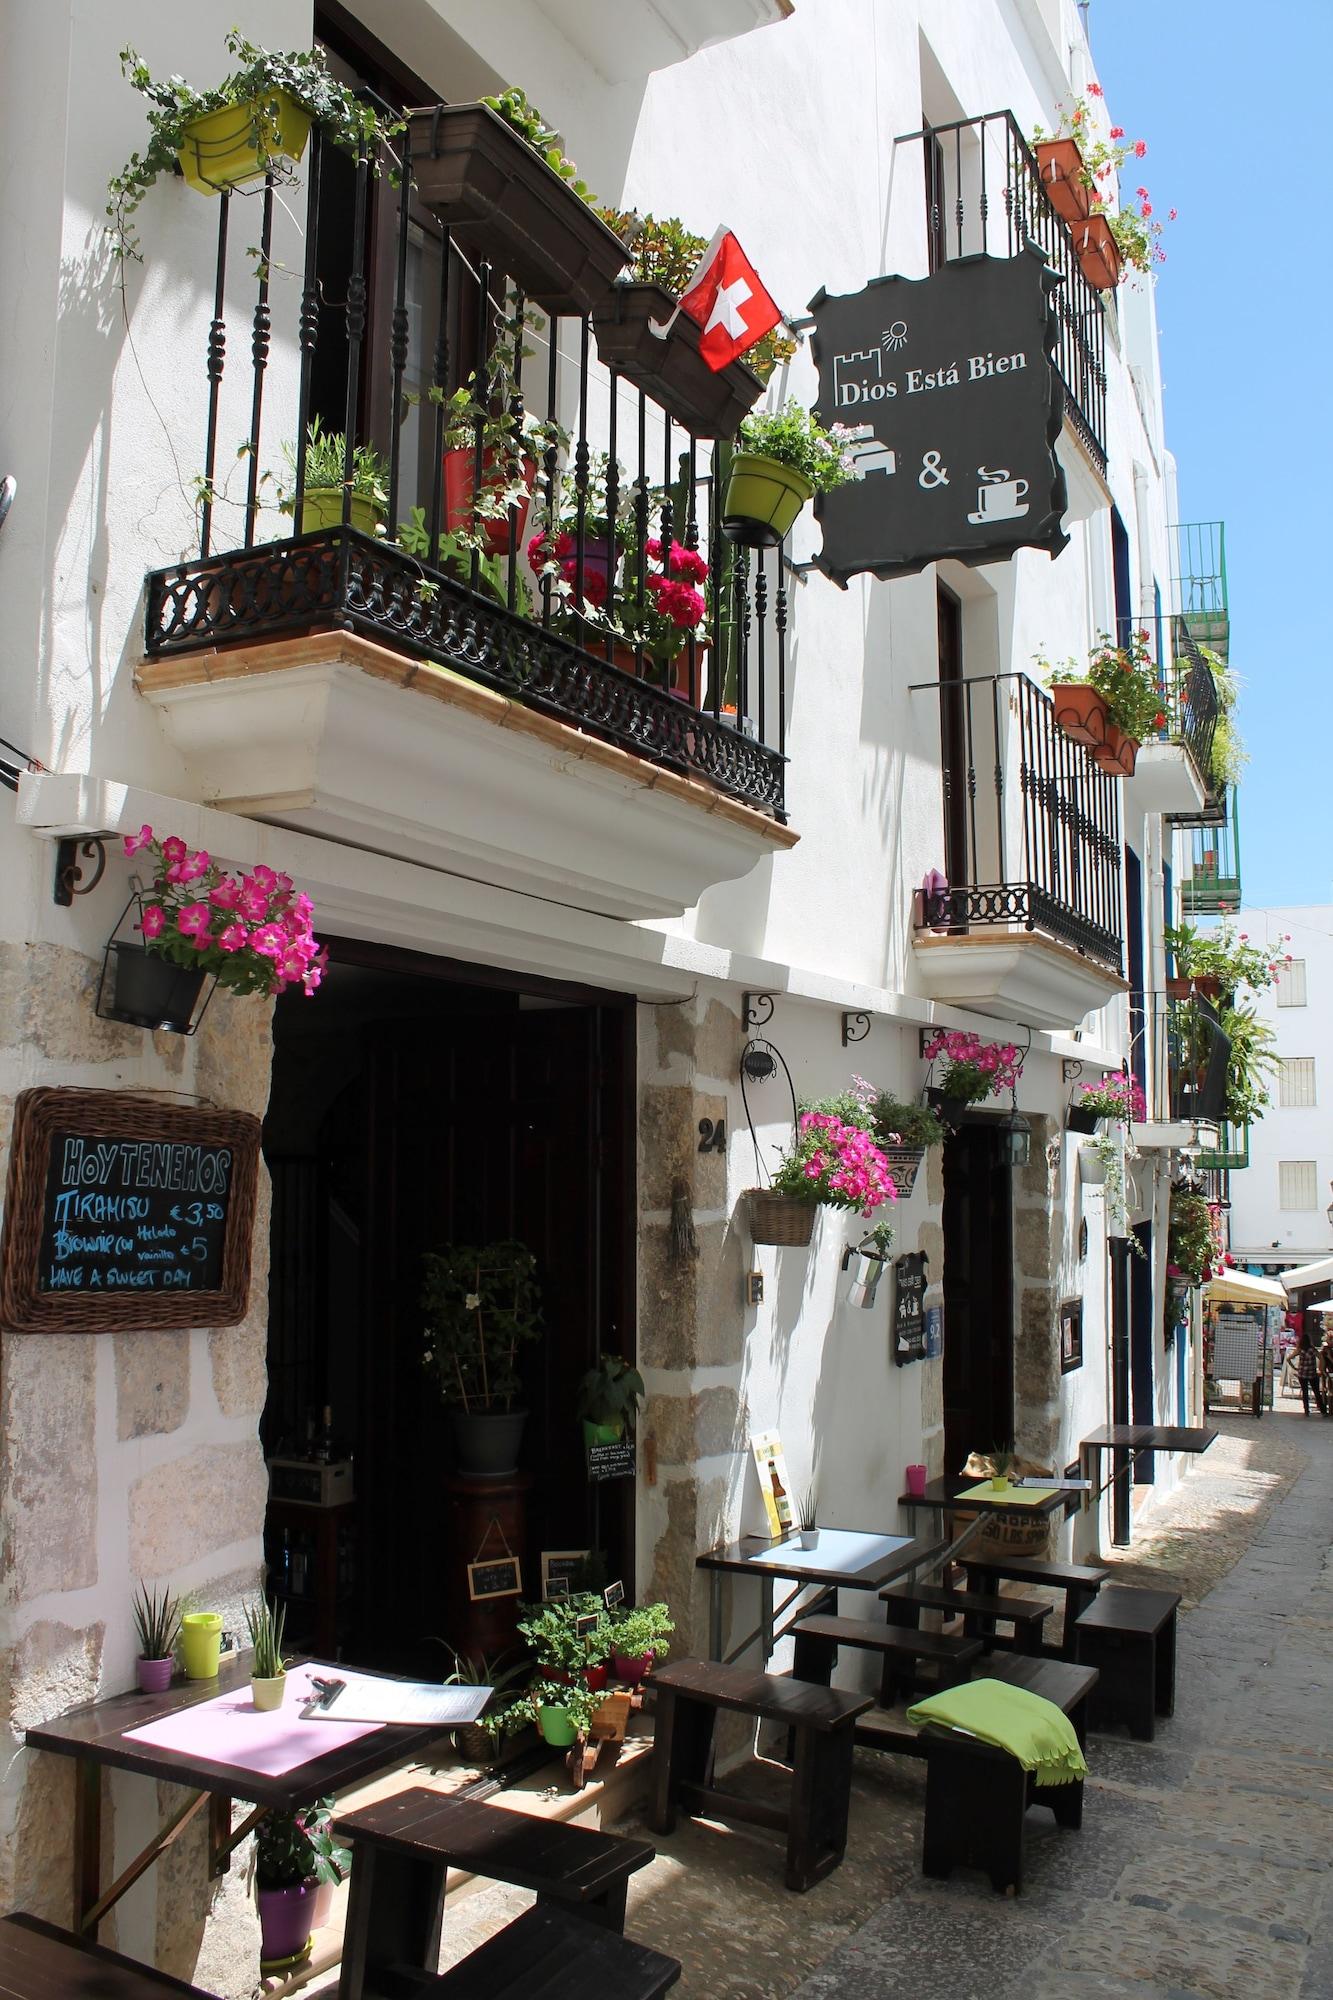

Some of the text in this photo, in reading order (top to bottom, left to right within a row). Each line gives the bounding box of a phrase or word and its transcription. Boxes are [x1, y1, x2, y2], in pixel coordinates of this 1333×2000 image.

[840, 350, 1028, 406] Dios Está Bien
[918, 450, 951, 490] &
[698, 1117, 726, 1153] 24
[120, 1142, 232, 1195] TENEMOS
[54, 1189, 151, 1226] TIRAMISU
[50, 1265, 192, 1289] HAVE A SWEET DAY
